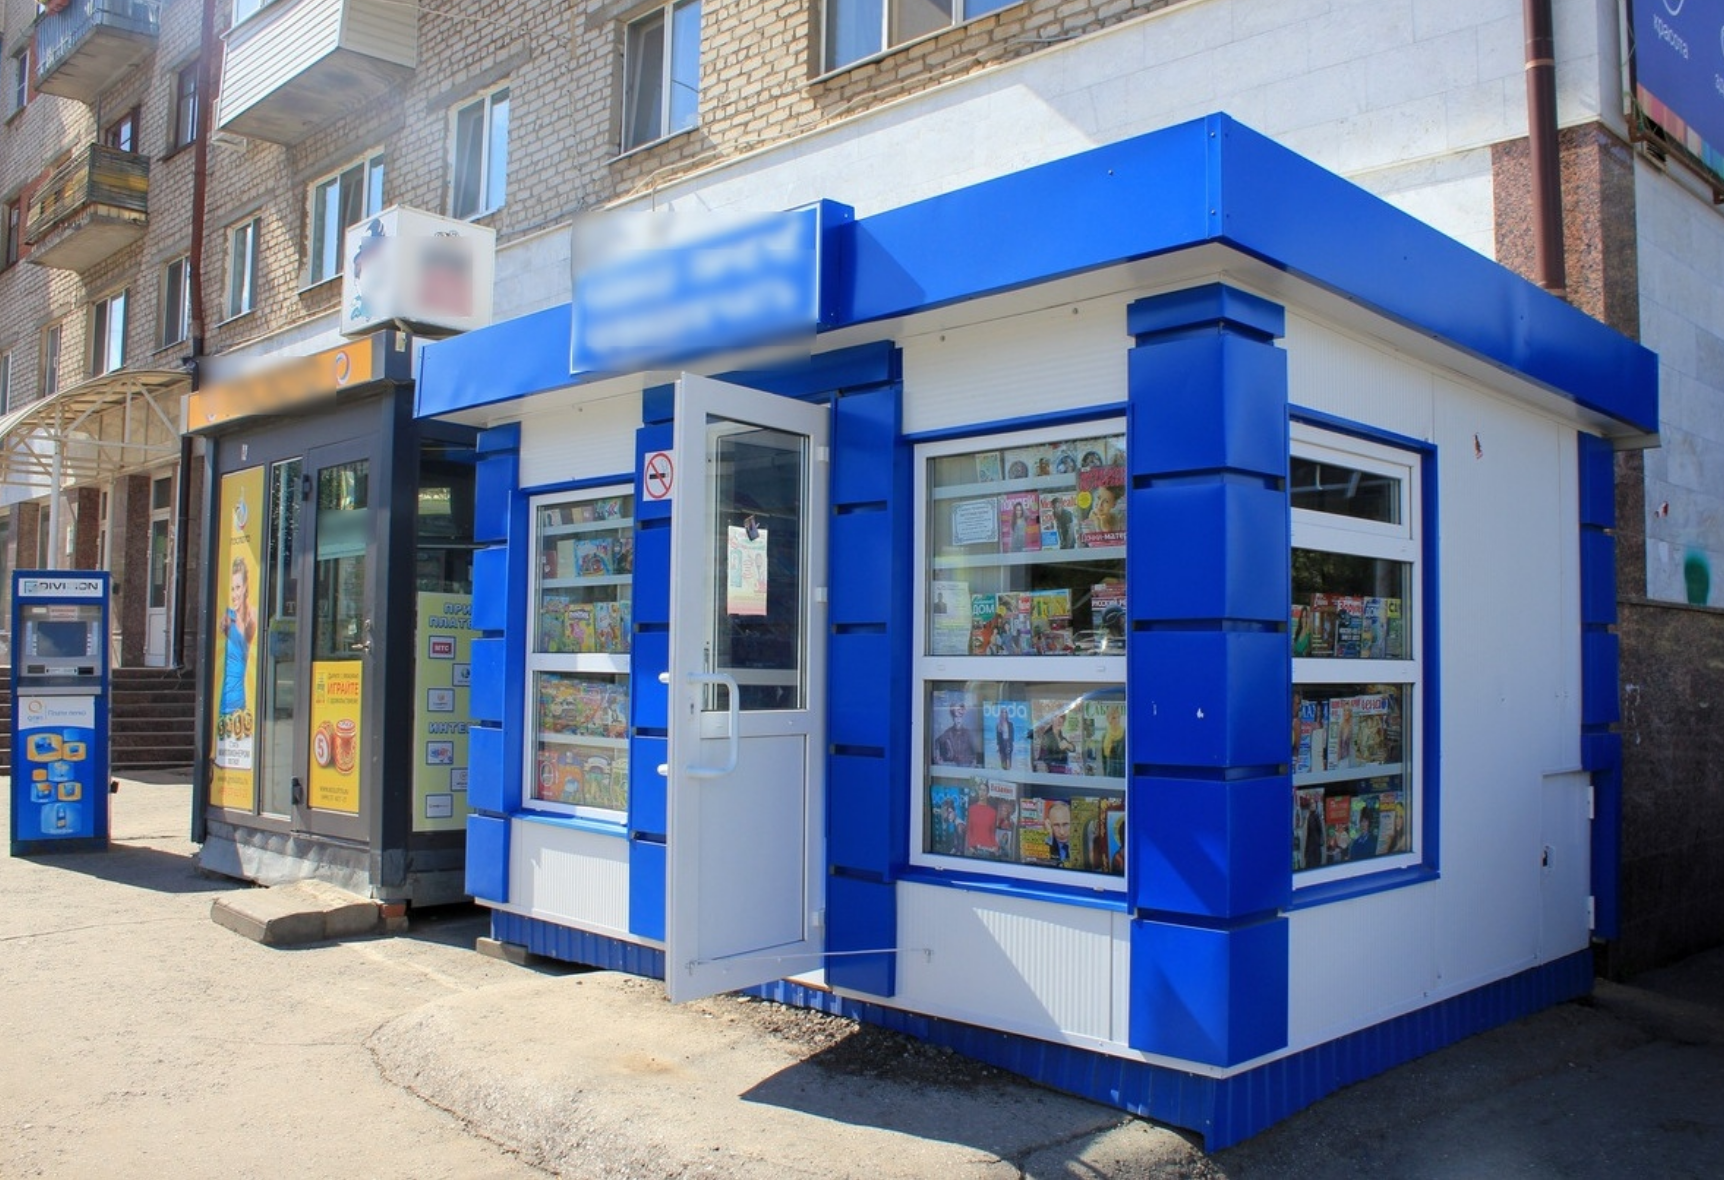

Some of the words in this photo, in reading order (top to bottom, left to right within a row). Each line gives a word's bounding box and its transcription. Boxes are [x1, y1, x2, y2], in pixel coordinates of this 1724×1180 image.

[1653, 13, 1689, 60] красота
[972, 604, 995, 616] ДОМ
[434, 644, 450, 652] МТС
[327, 681, 359, 696] ИГРАЙТЕ
